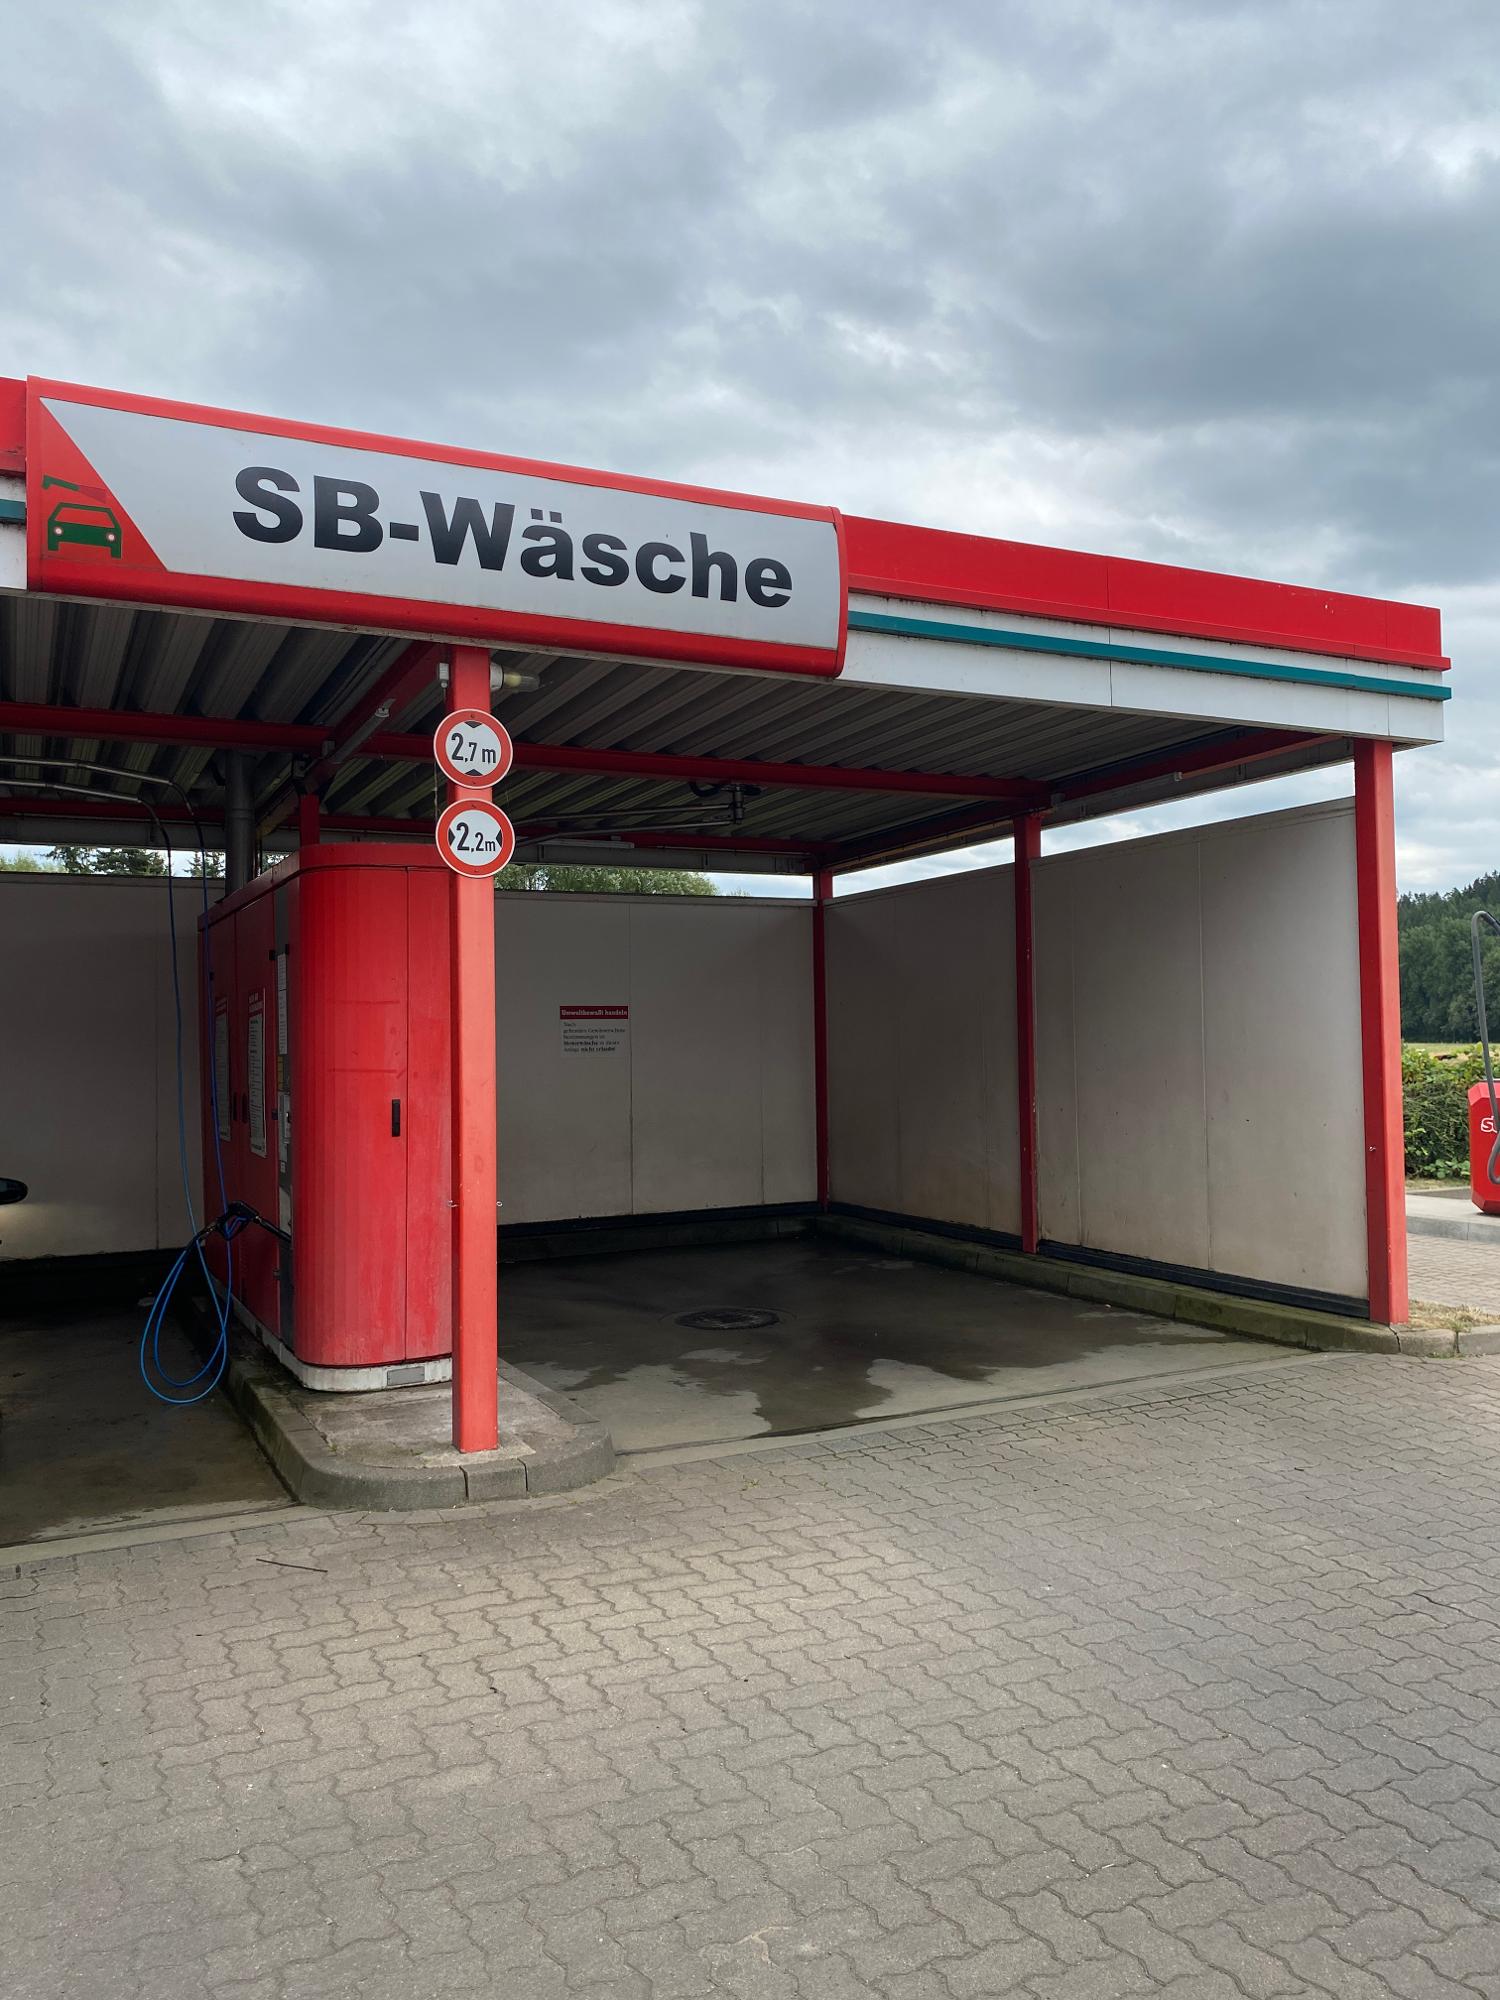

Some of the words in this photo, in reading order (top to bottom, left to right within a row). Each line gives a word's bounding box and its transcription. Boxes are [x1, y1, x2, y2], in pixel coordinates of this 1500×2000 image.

[233, 466, 794, 608] SB-Wäsche
[451, 732, 478, 763] 2,7
[481, 748, 497, 764] m
